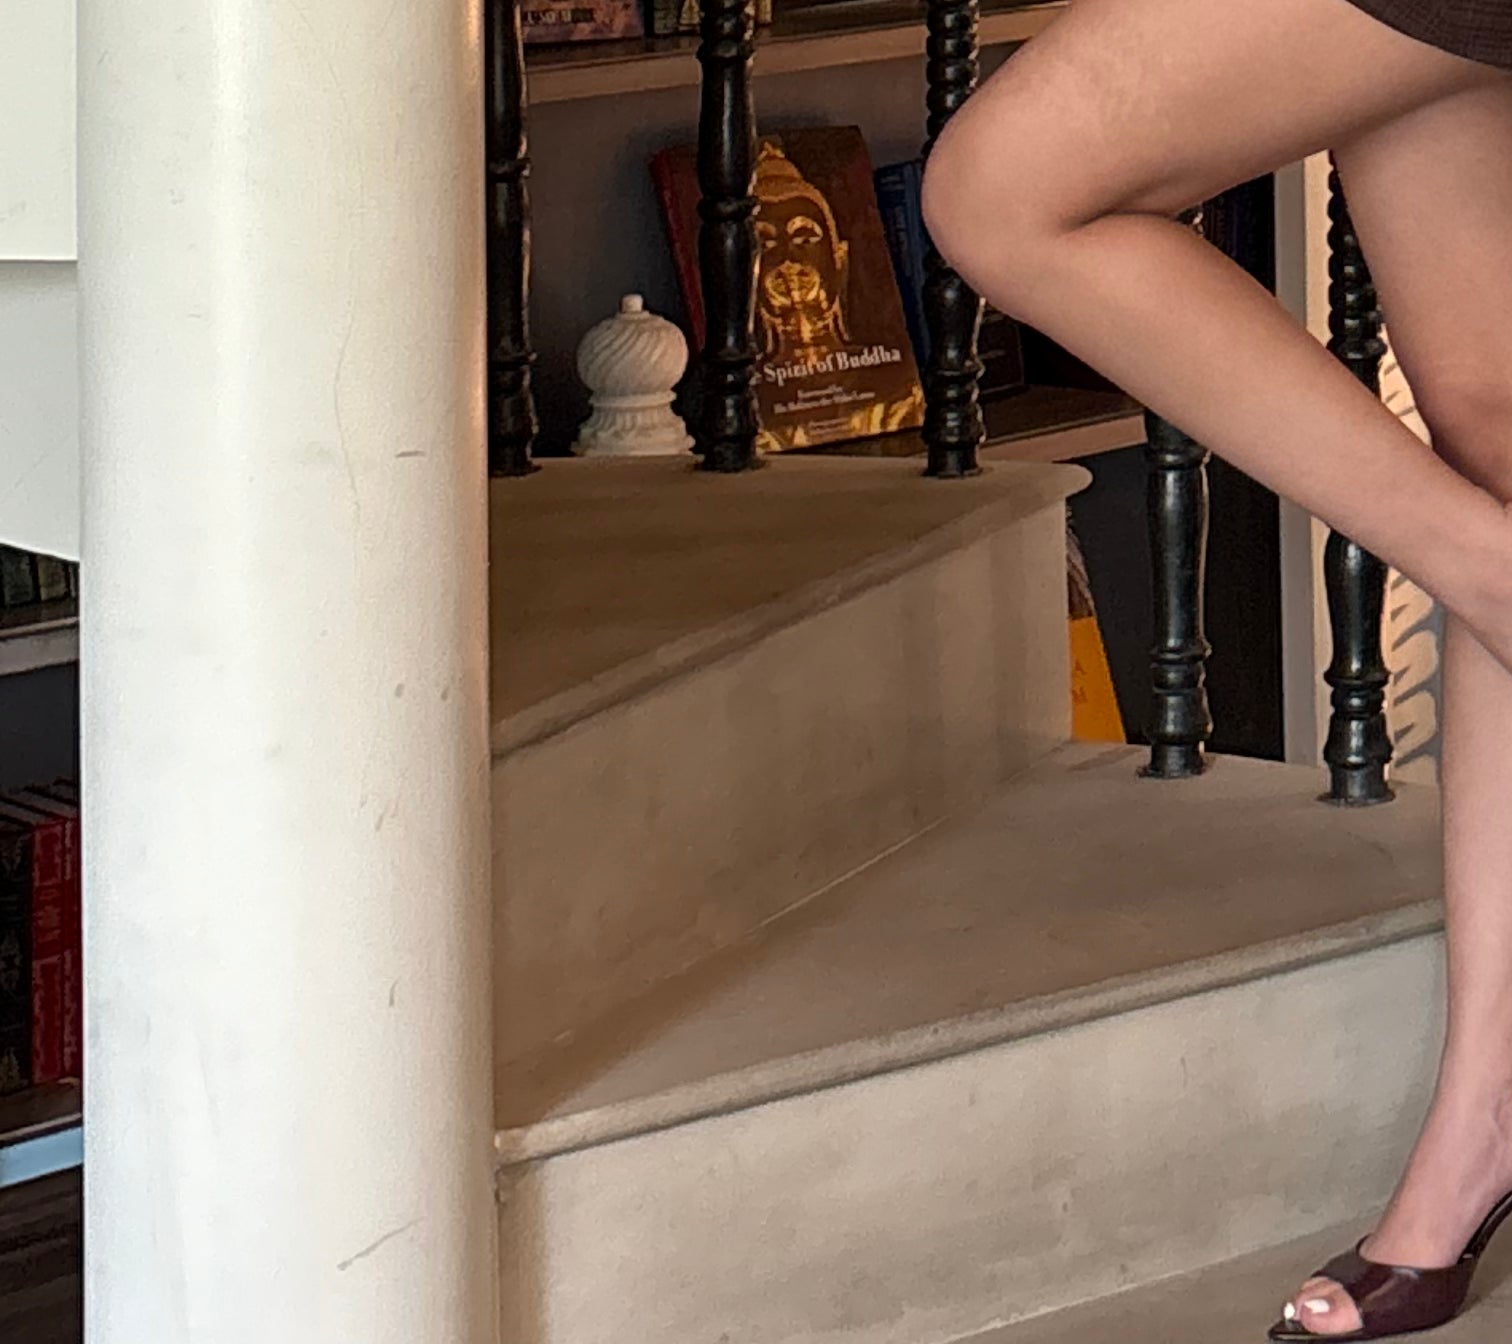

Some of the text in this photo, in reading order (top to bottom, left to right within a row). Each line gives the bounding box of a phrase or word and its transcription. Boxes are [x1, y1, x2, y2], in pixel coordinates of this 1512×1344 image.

[763, 357, 815, 387] Spirit
[816, 353, 834, 374] of
[836, 345, 902, 371] Buddha
